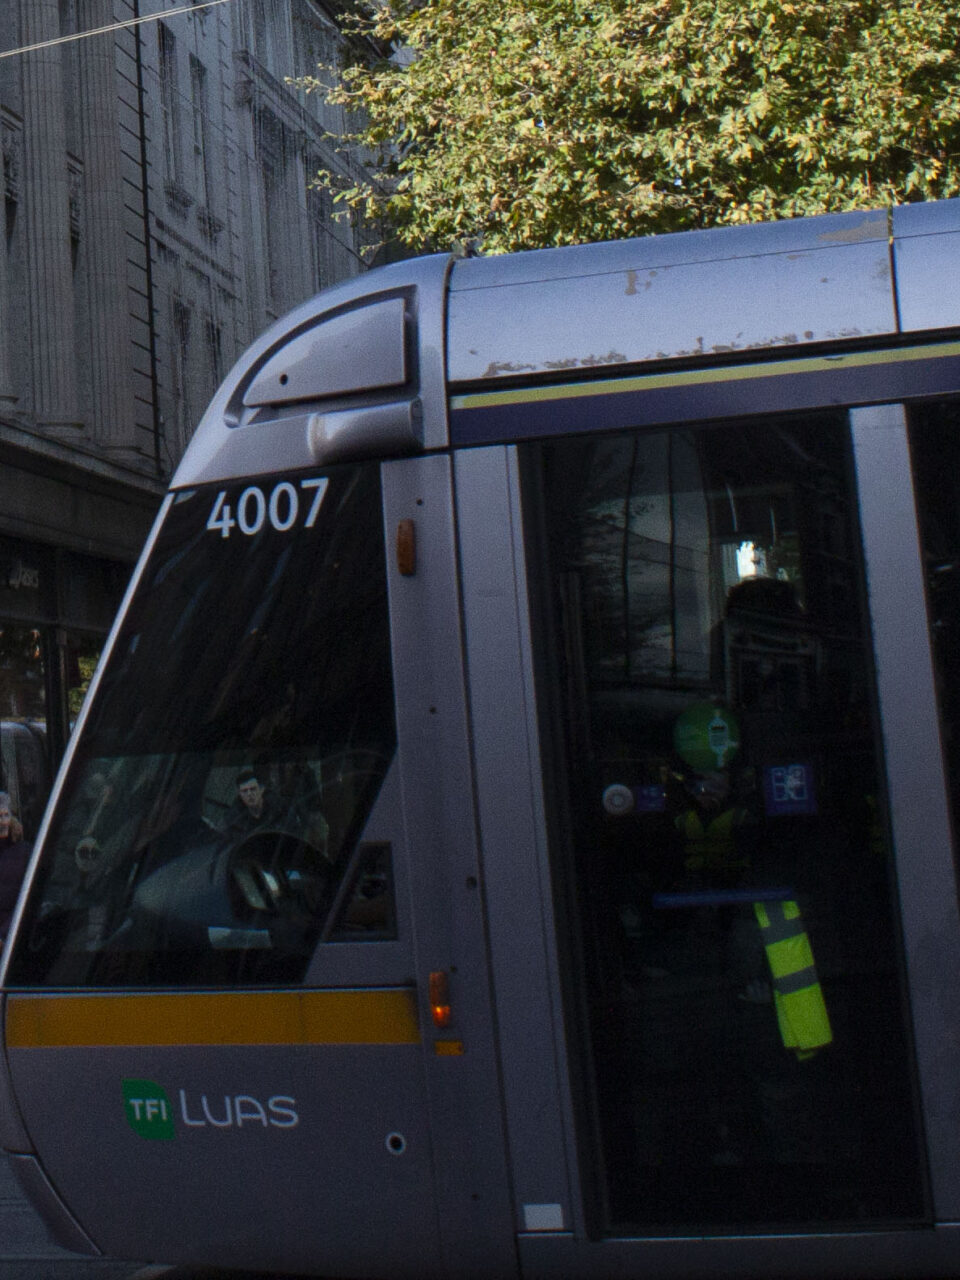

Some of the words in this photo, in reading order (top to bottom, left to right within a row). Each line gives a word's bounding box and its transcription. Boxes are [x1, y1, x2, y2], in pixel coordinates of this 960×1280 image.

[206, 476, 330, 539] 4007
[129, 1097, 169, 1122] TFI
[179, 1089, 300, 1128] LUAS
